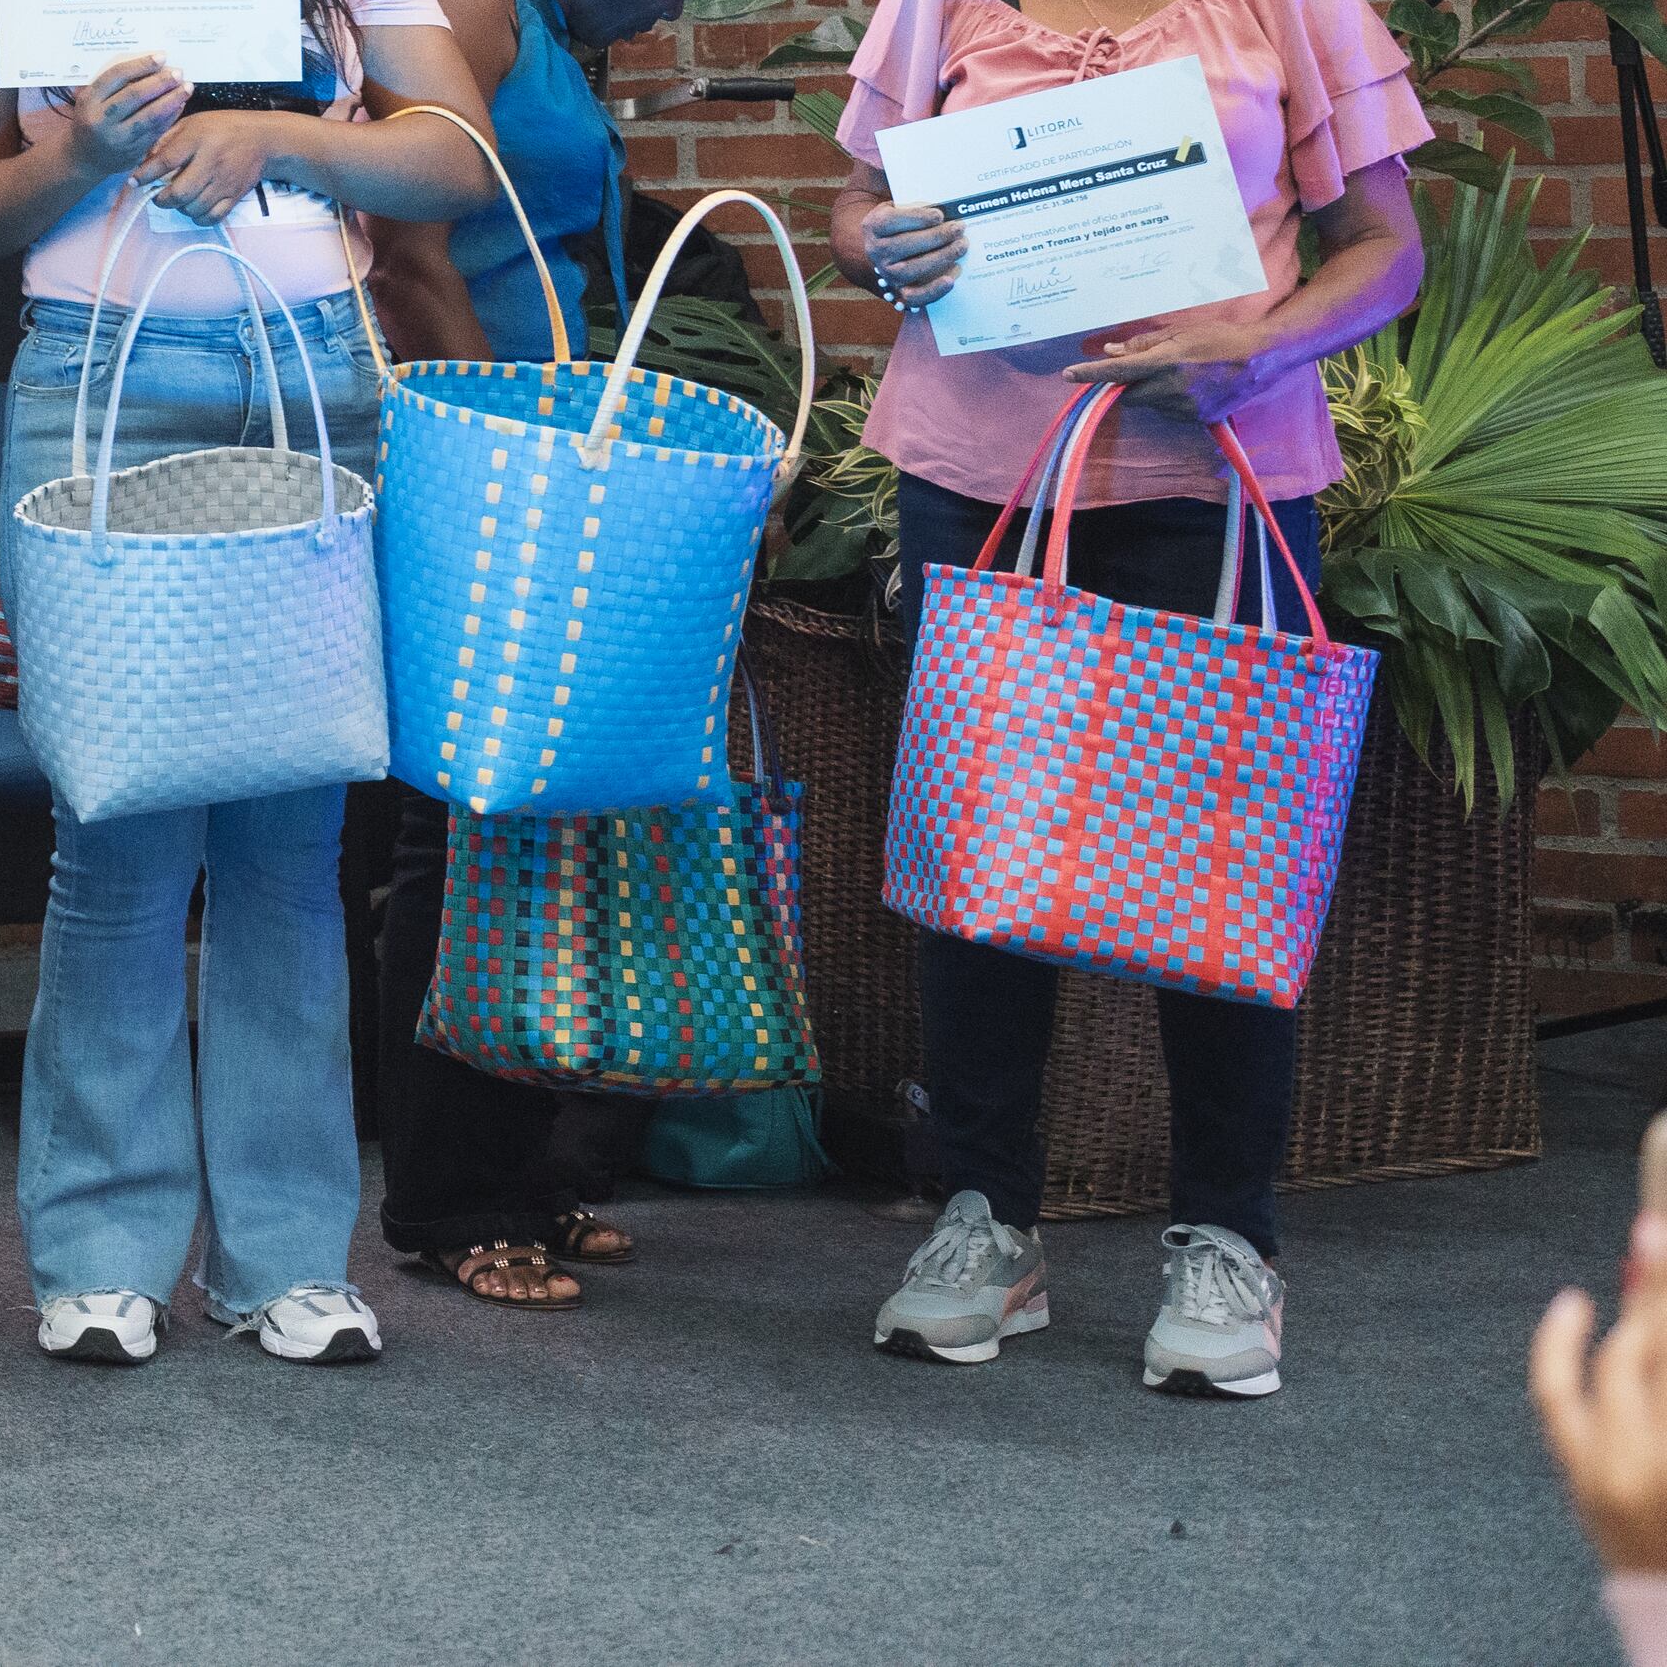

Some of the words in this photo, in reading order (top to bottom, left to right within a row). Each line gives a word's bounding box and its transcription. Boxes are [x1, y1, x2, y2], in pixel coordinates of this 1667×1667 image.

[1026, 116, 1083, 137] LITORAL
[976, 159, 1041, 182] CERTIFICADO
[1042, 155, 1058, 166] DE
[1057, 136, 1132, 162] PARTICIPACIÓN
[957, 194, 1008, 215] Carmen
[1010, 182, 1058, 202] Helena
[1059, 173, 1093, 191] Mera
[1094, 164, 1135, 182] Santa
[1135, 156, 1169, 173] Cruz
[1034, 202, 1049, 211] C.C.
[983, 235, 1020, 250] Proceso
[1021, 224, 1067, 241] formativo
[1067, 222, 1079, 231] en
[1080, 218, 1090, 227] el
[1092, 212, 1118, 225] oficio
[1030, 243, 1044, 252] en
[1046, 233, 1081, 248] Trenza
[1083, 233, 1090, 241] y
[1092, 224, 1123, 239] tejido
[1124, 221, 1138, 230] en
[1140, 214, 1170, 228] sarga
